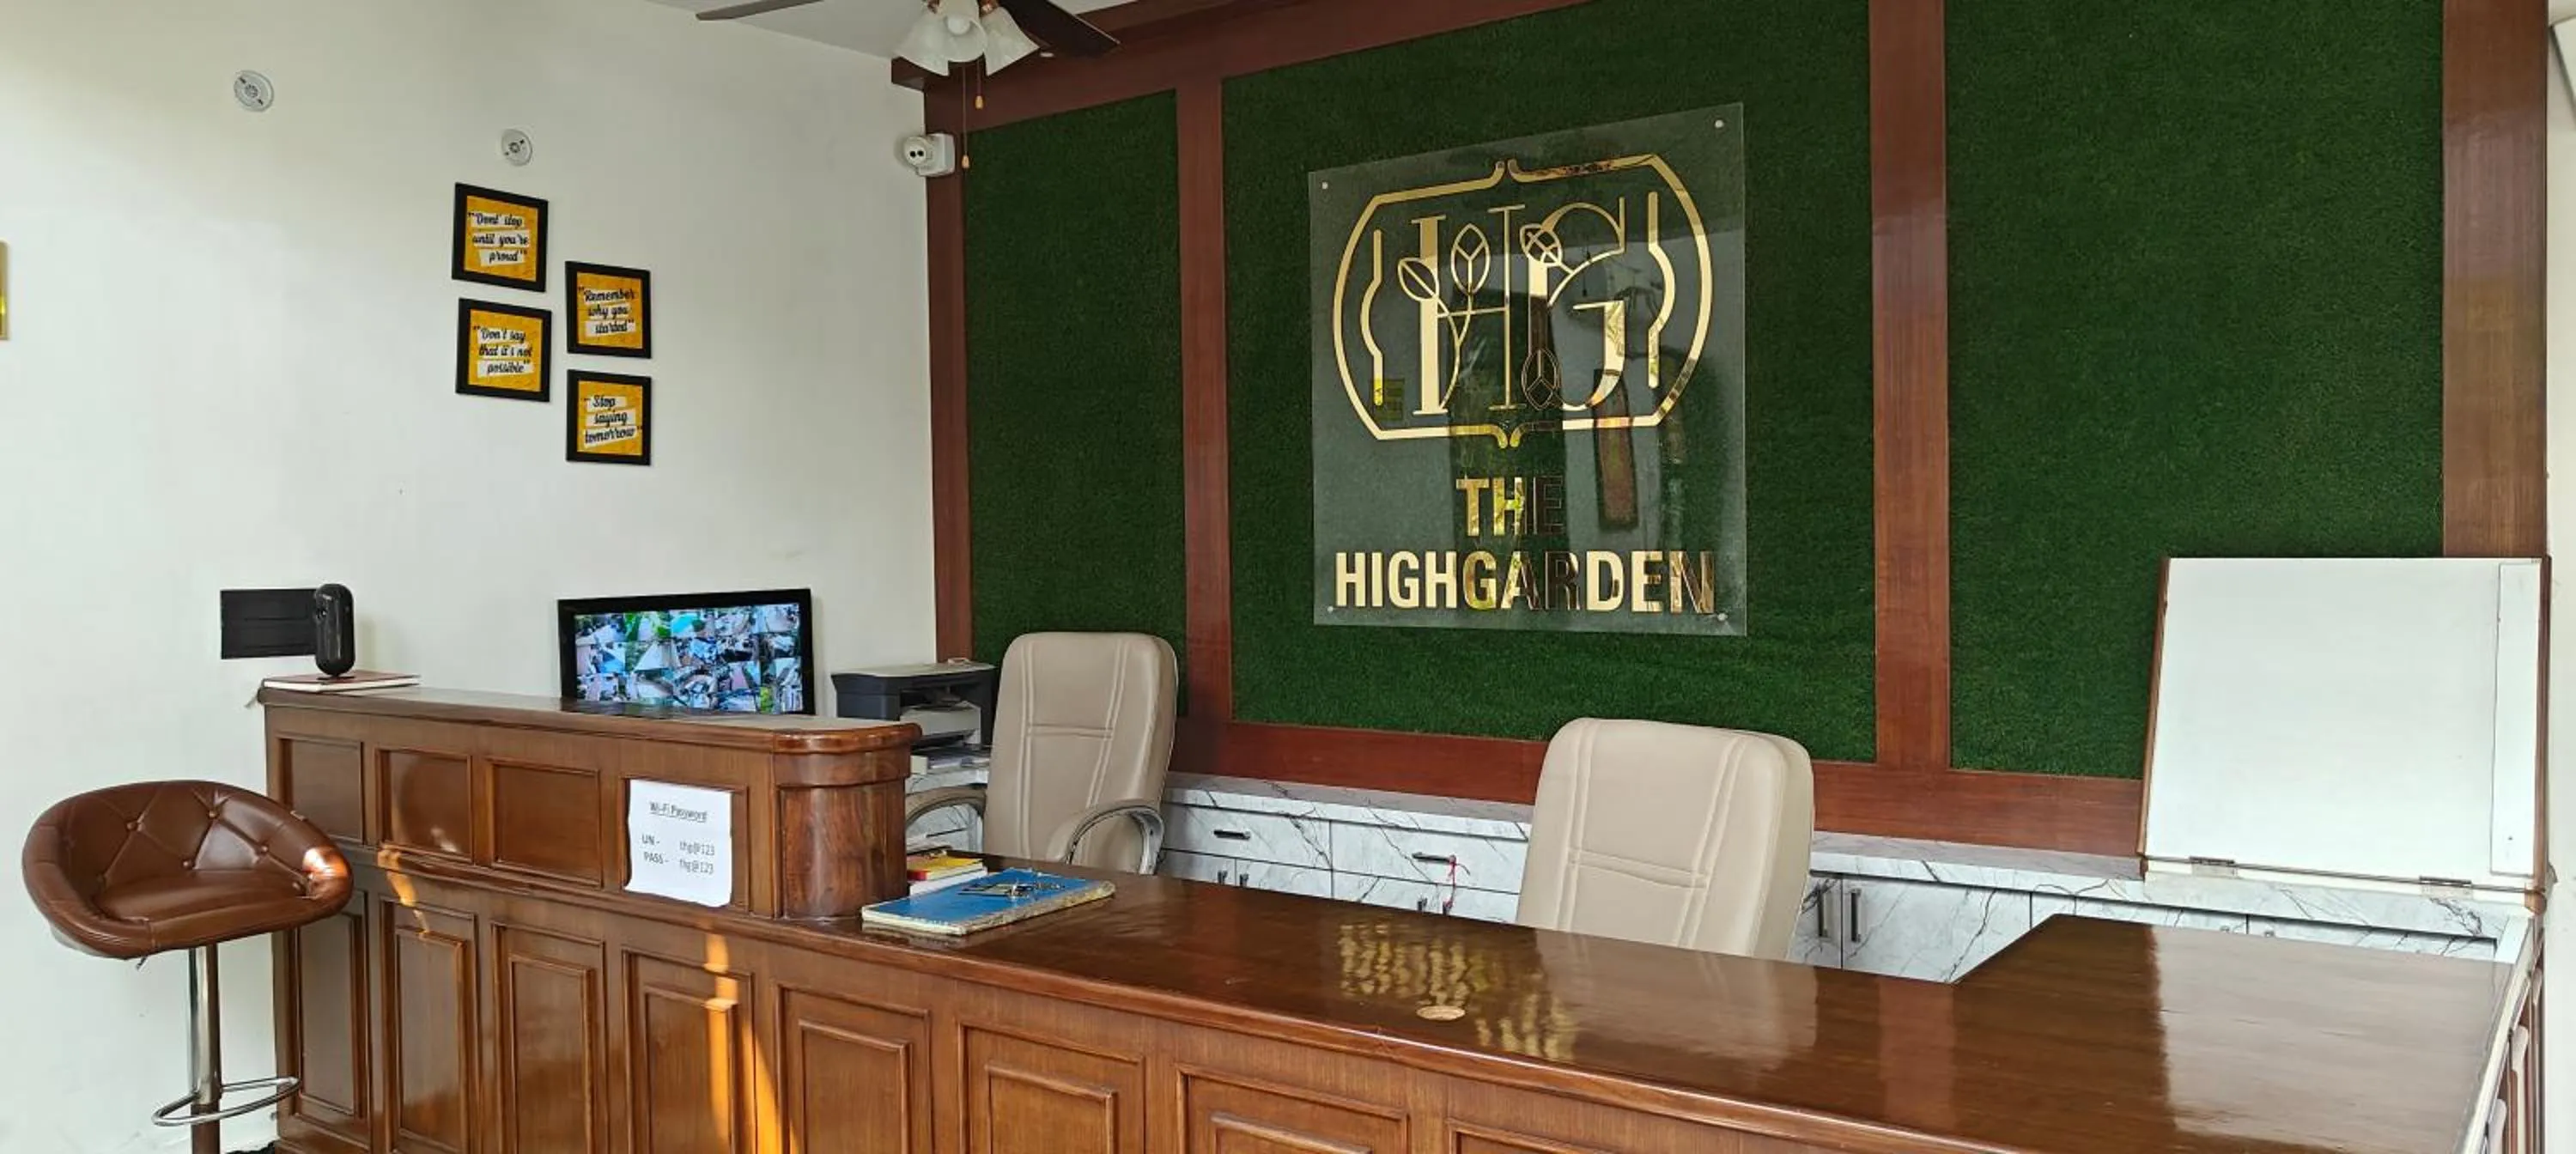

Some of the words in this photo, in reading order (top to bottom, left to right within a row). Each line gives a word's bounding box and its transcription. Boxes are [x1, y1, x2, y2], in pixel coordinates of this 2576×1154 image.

[472, 233, 495, 245] until
[588, 304, 609, 319] why
[611, 306, 628, 319] you
[509, 331, 526, 344] say
[478, 343, 498, 356] that
[517, 346, 533, 357] not
[594, 409, 629, 428] saying
[1456, 477, 1564, 538] THE
[1335, 550, 1716, 615] HIGHGARDEN
